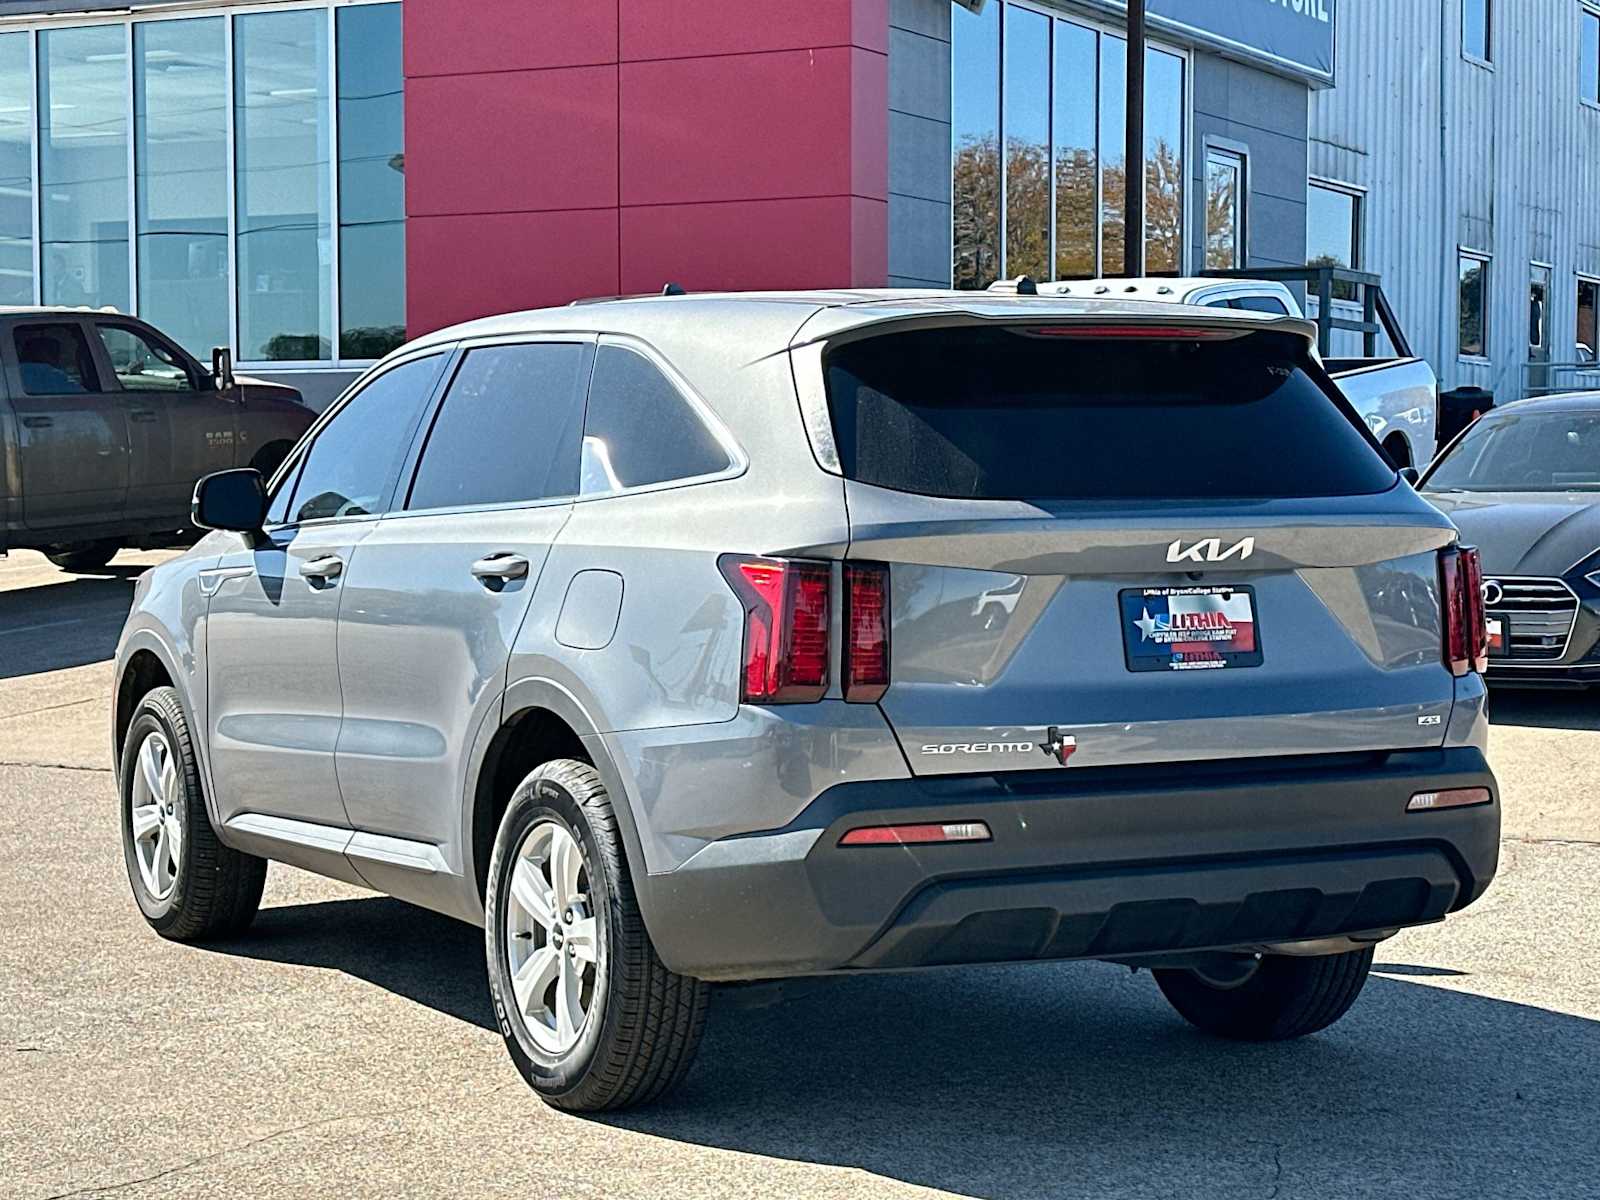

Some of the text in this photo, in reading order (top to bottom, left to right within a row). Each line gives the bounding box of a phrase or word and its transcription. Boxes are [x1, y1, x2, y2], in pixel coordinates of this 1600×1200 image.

[1166, 536, 1255, 562] KIA
[1171, 611, 1233, 630] LITHIA
[921, 742, 1033, 755] SORENTO
